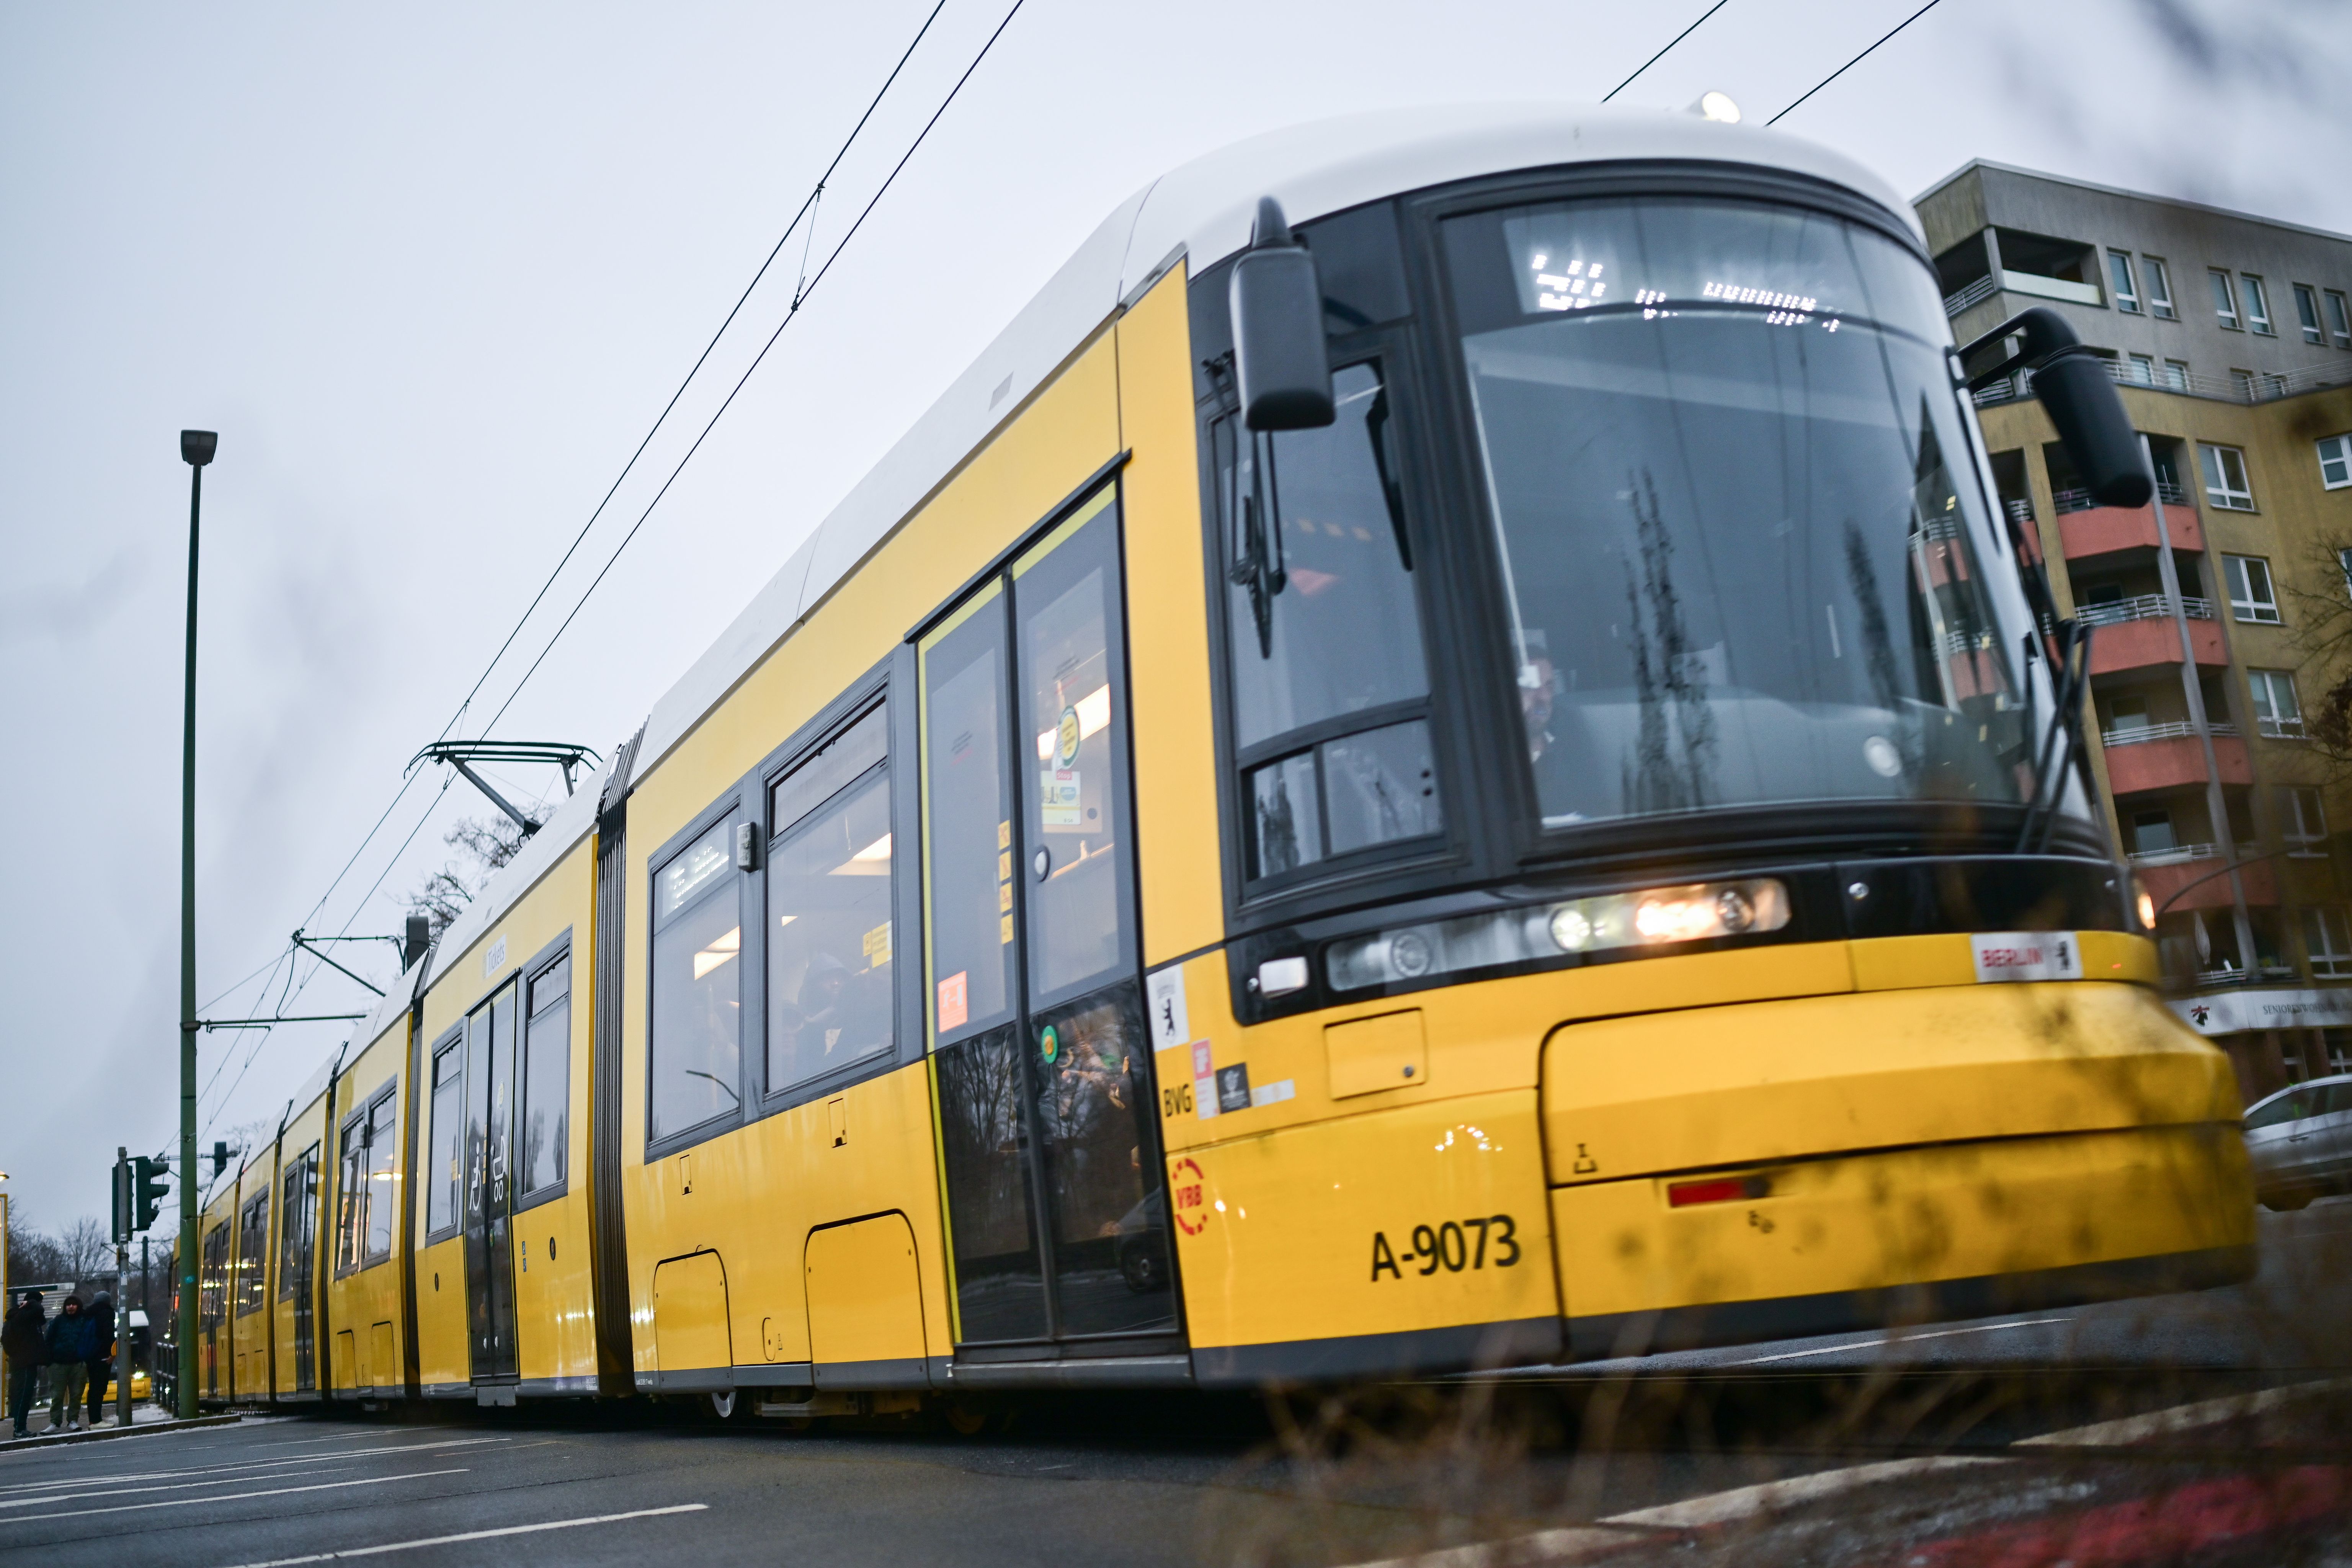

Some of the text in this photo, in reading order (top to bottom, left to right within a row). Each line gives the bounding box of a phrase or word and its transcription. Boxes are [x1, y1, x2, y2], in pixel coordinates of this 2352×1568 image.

[488, 943, 504, 973] Tickets
[1981, 947, 2043, 967] BERLIN
[1164, 1083, 1192, 1117] BVG
[1176, 1184, 1202, 1210] VBB
[1371, 1214, 1521, 1282] A-9073
